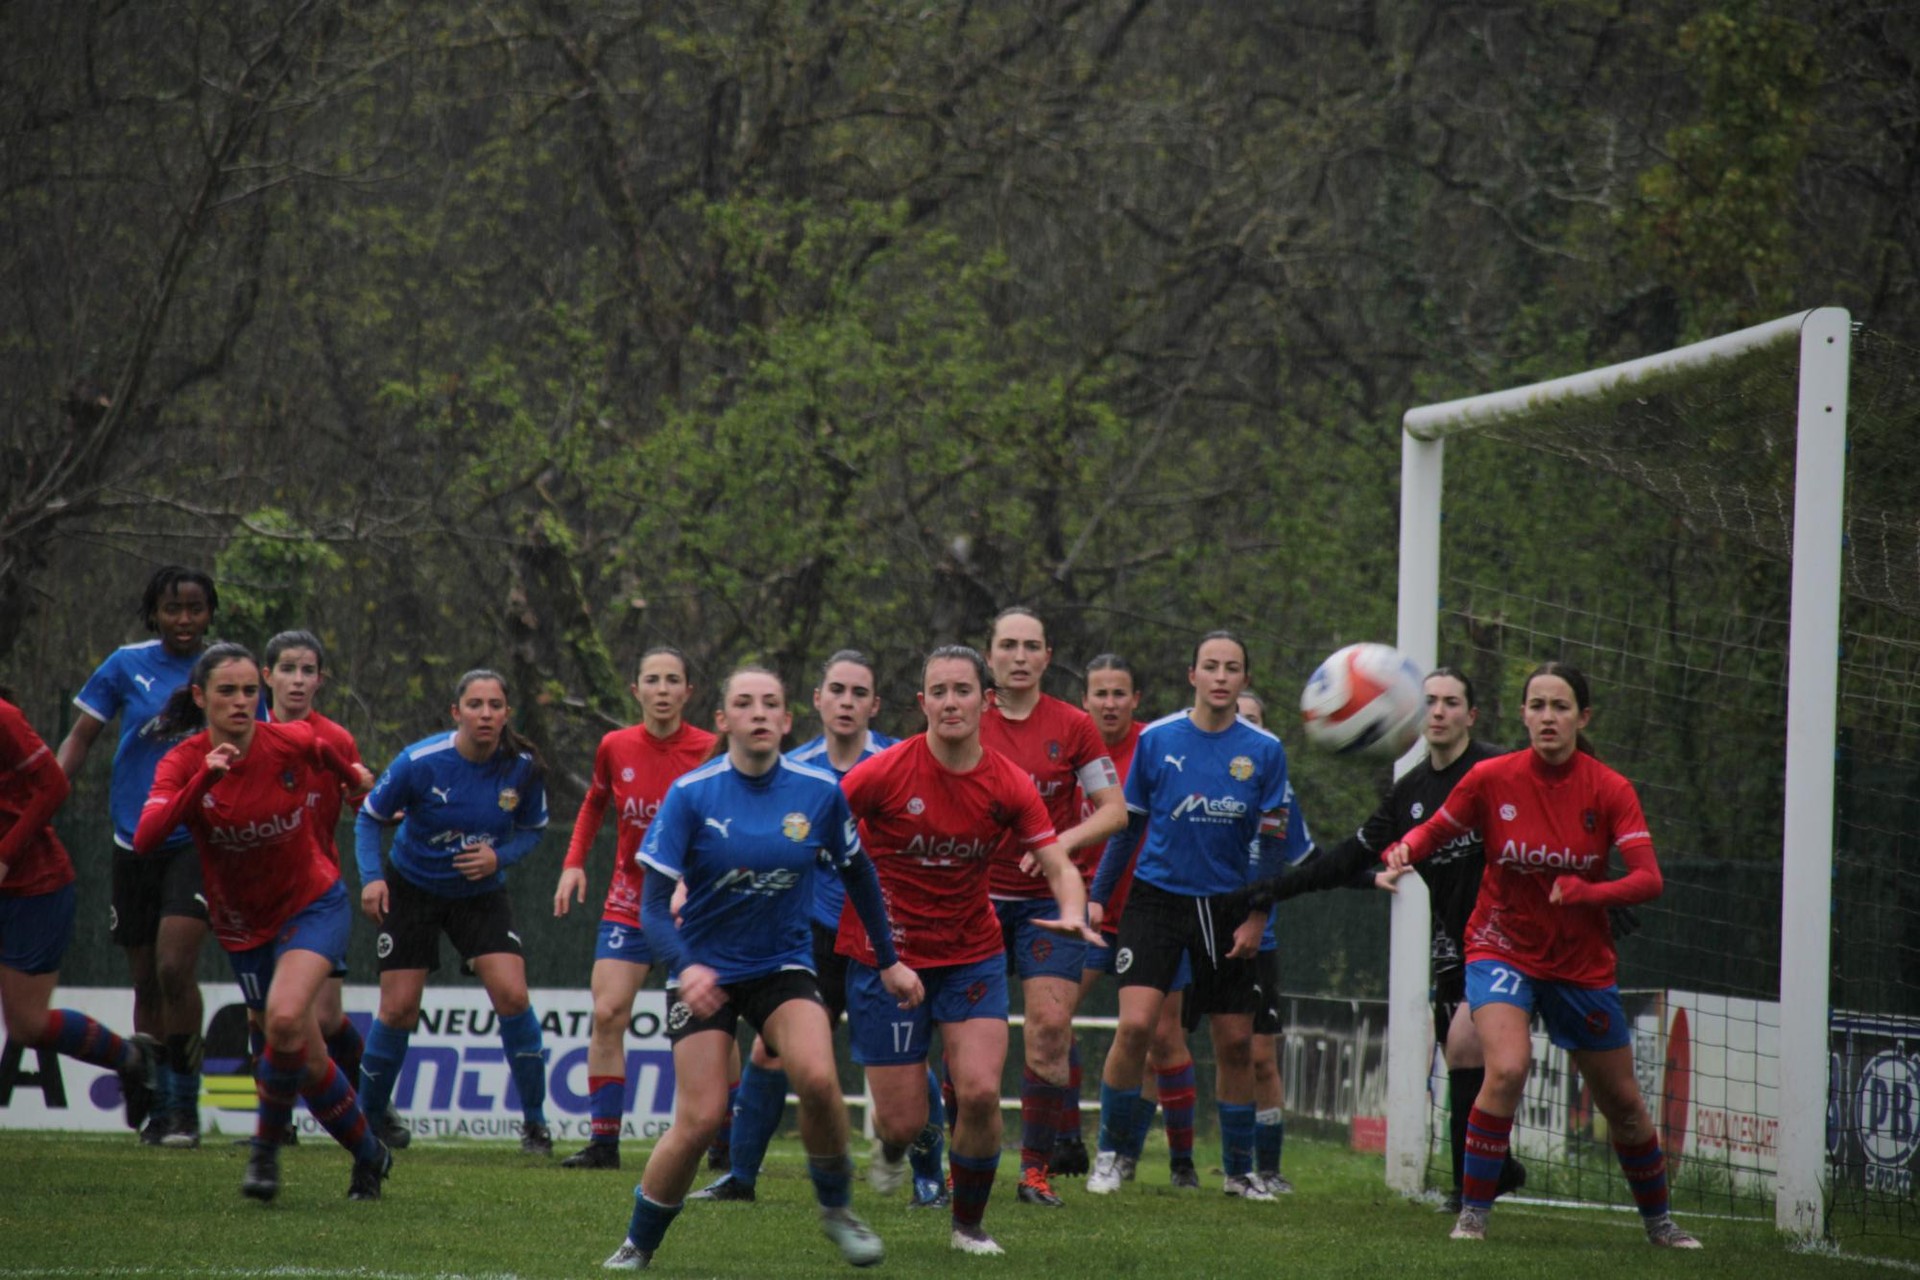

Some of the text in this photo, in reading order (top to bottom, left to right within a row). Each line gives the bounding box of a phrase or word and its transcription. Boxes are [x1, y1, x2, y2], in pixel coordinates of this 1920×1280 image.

[1497, 839, 1600, 870] Aldalur
[1490, 967, 1520, 995] 27
[891, 1021, 914, 1053] 17
